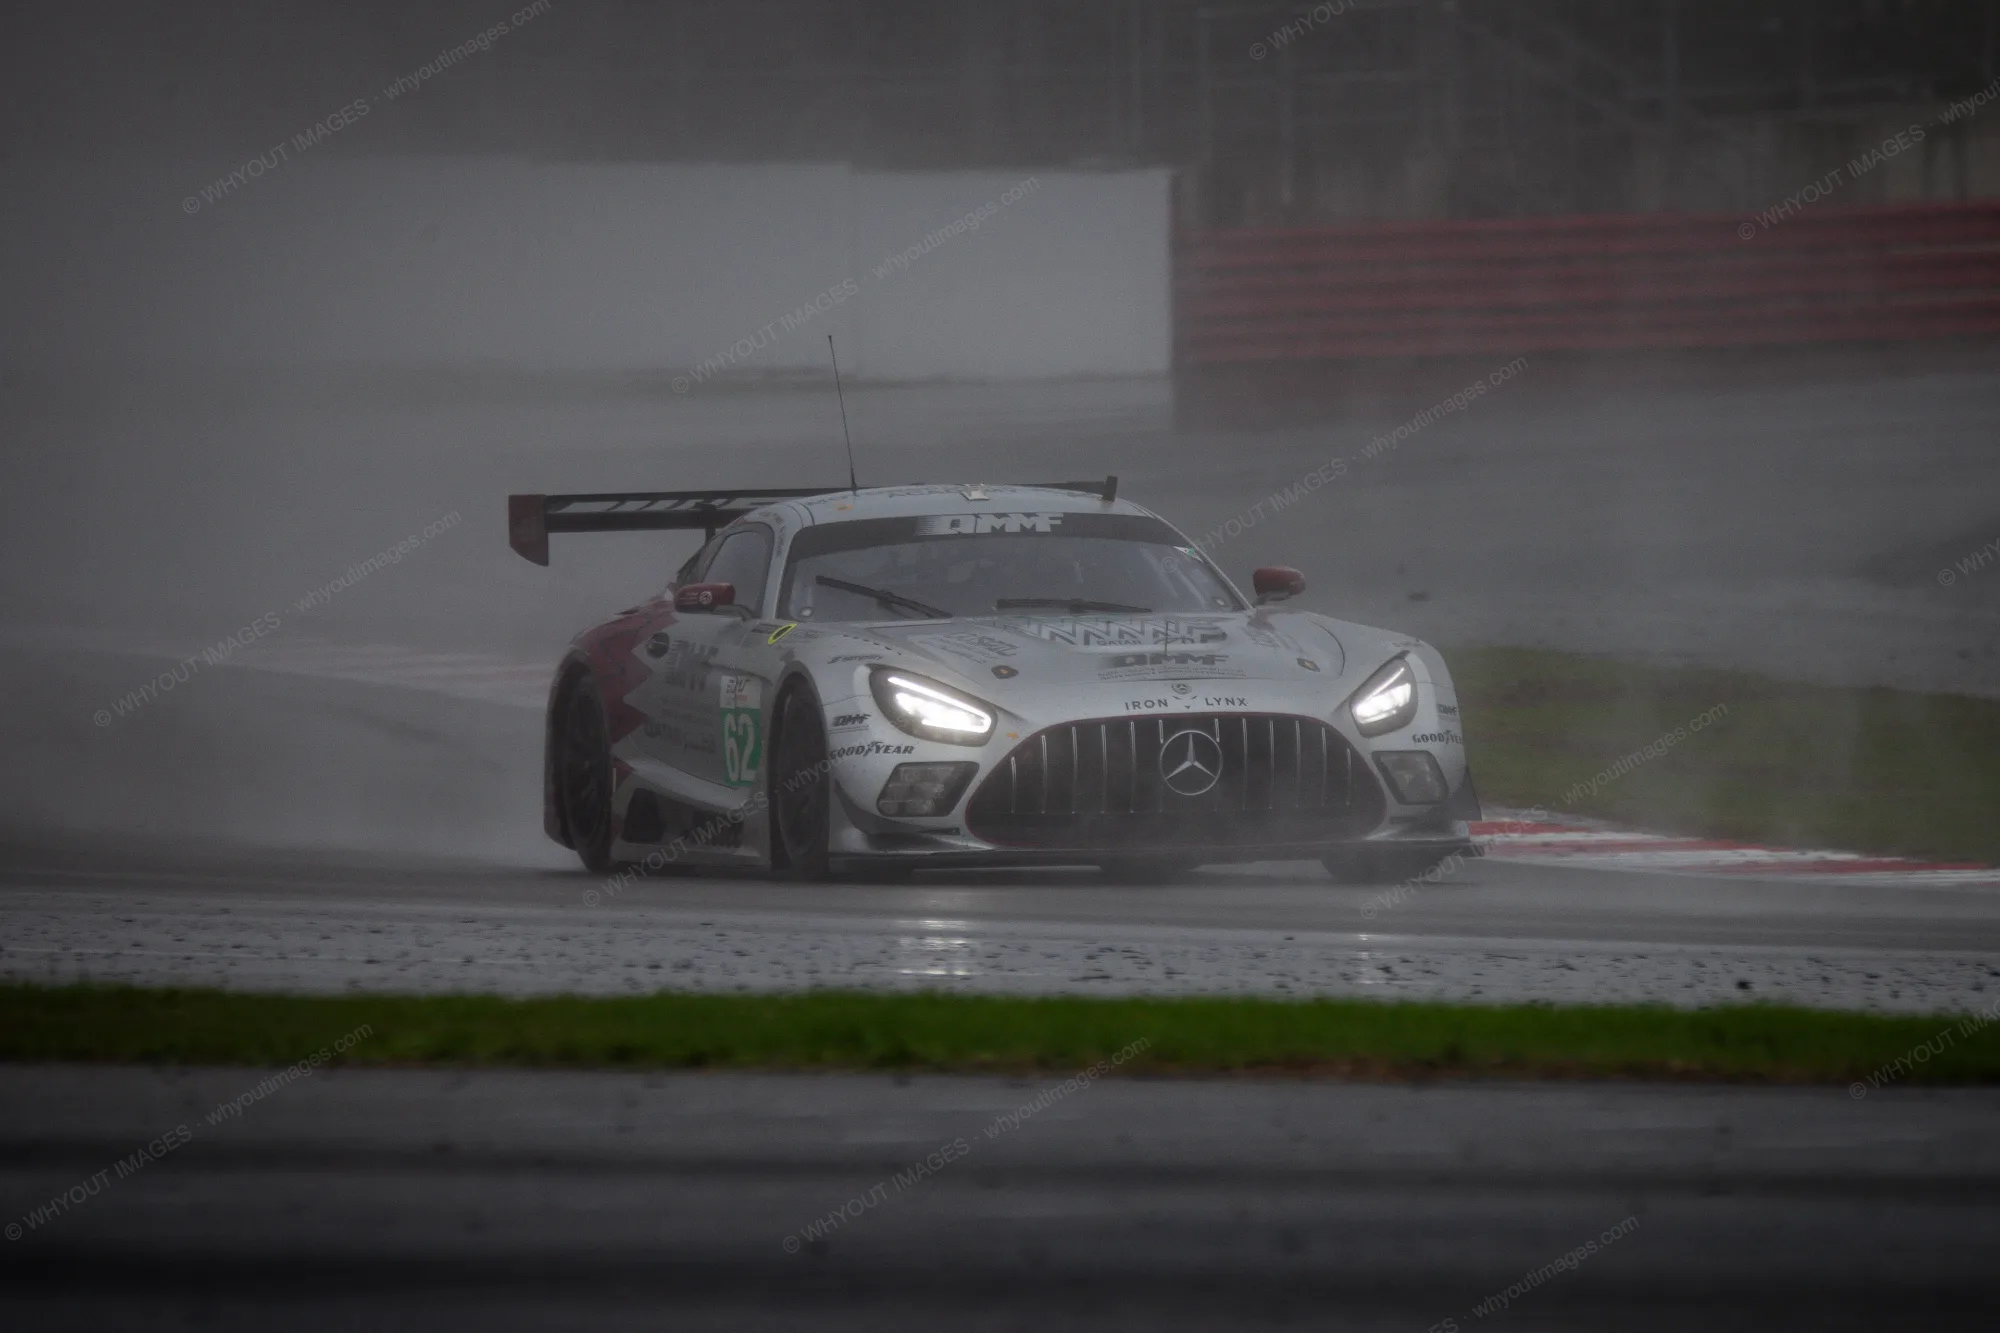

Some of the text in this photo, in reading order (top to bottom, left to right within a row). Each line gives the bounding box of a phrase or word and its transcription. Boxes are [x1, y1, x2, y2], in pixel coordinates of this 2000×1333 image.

[1125, 696, 1248, 711] IRON LYNX
[724, 713, 757, 783] 62
